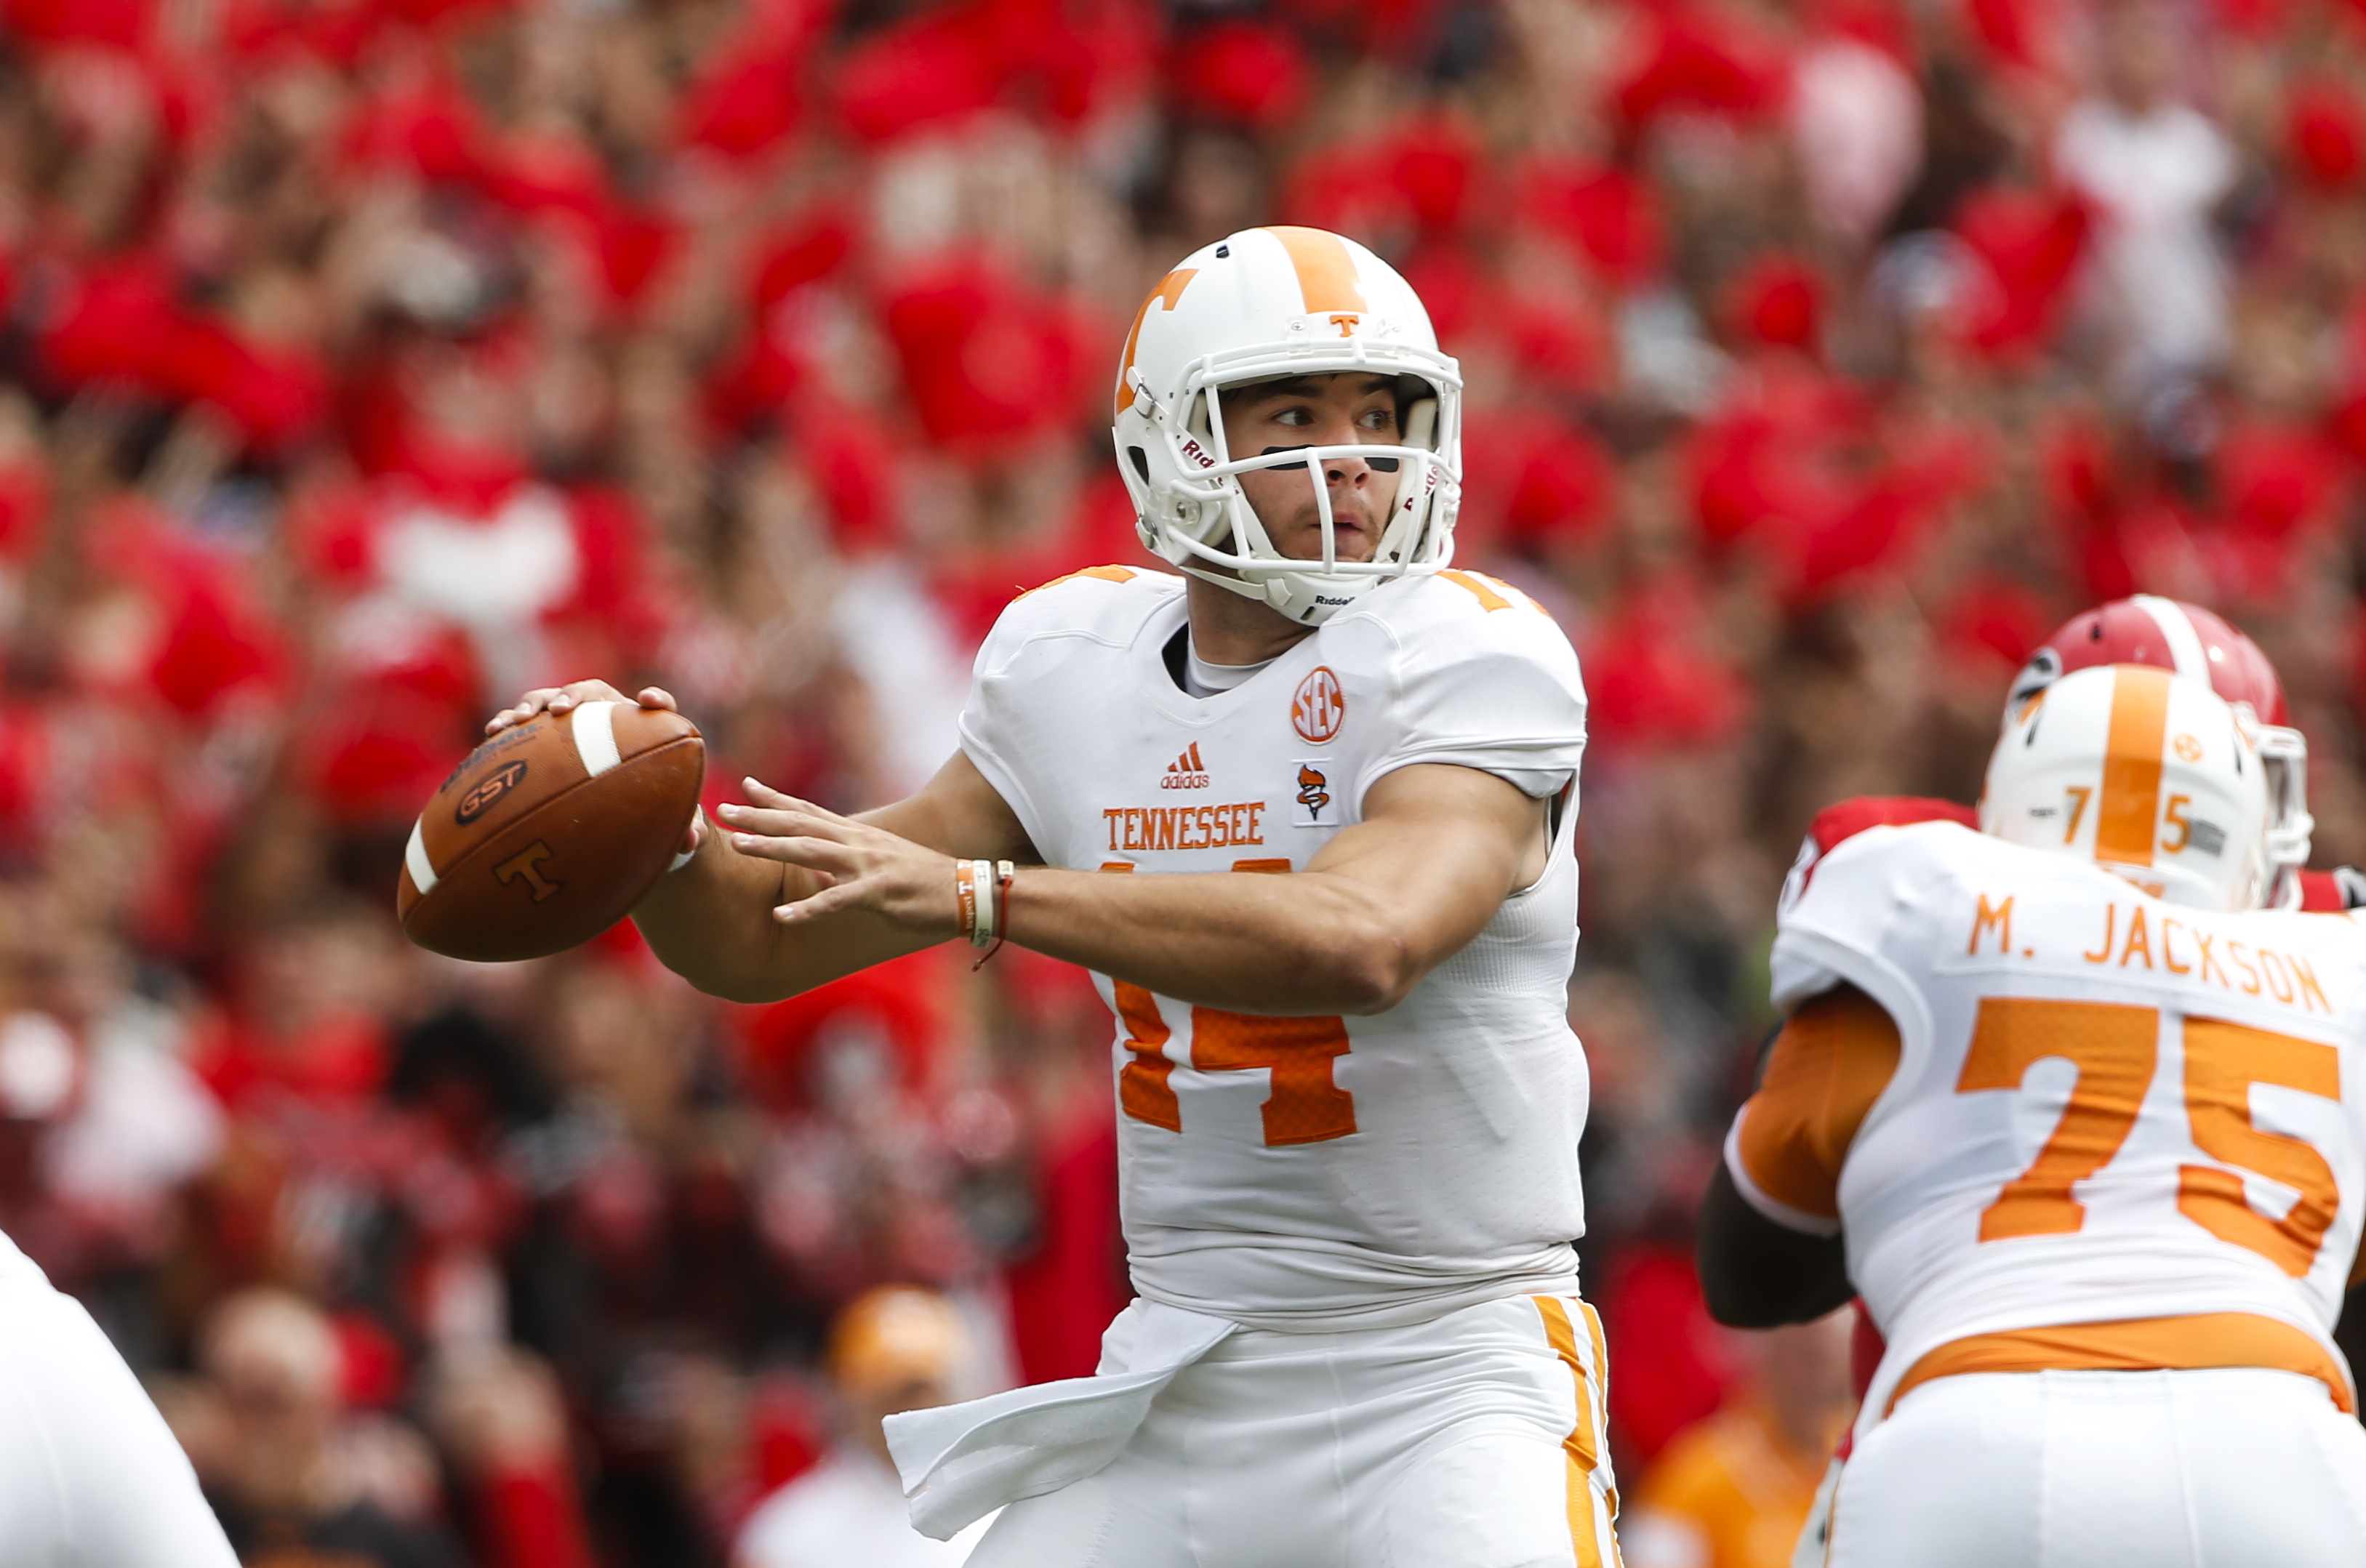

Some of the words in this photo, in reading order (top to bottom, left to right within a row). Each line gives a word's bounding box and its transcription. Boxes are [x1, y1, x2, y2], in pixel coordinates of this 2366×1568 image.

[1329, 315, 1358, 338] T
[1294, 670, 1344, 739] SEC
[460, 763, 524, 817] GST
[1160, 770, 1211, 790] adidas
[1102, 800, 1266, 851] TENNESSEE
[493, 839, 564, 904] T
[1968, 893, 2034, 957] M.
[2084, 902, 2333, 1015] JACKSON
[1954, 995, 2341, 1279] 75
